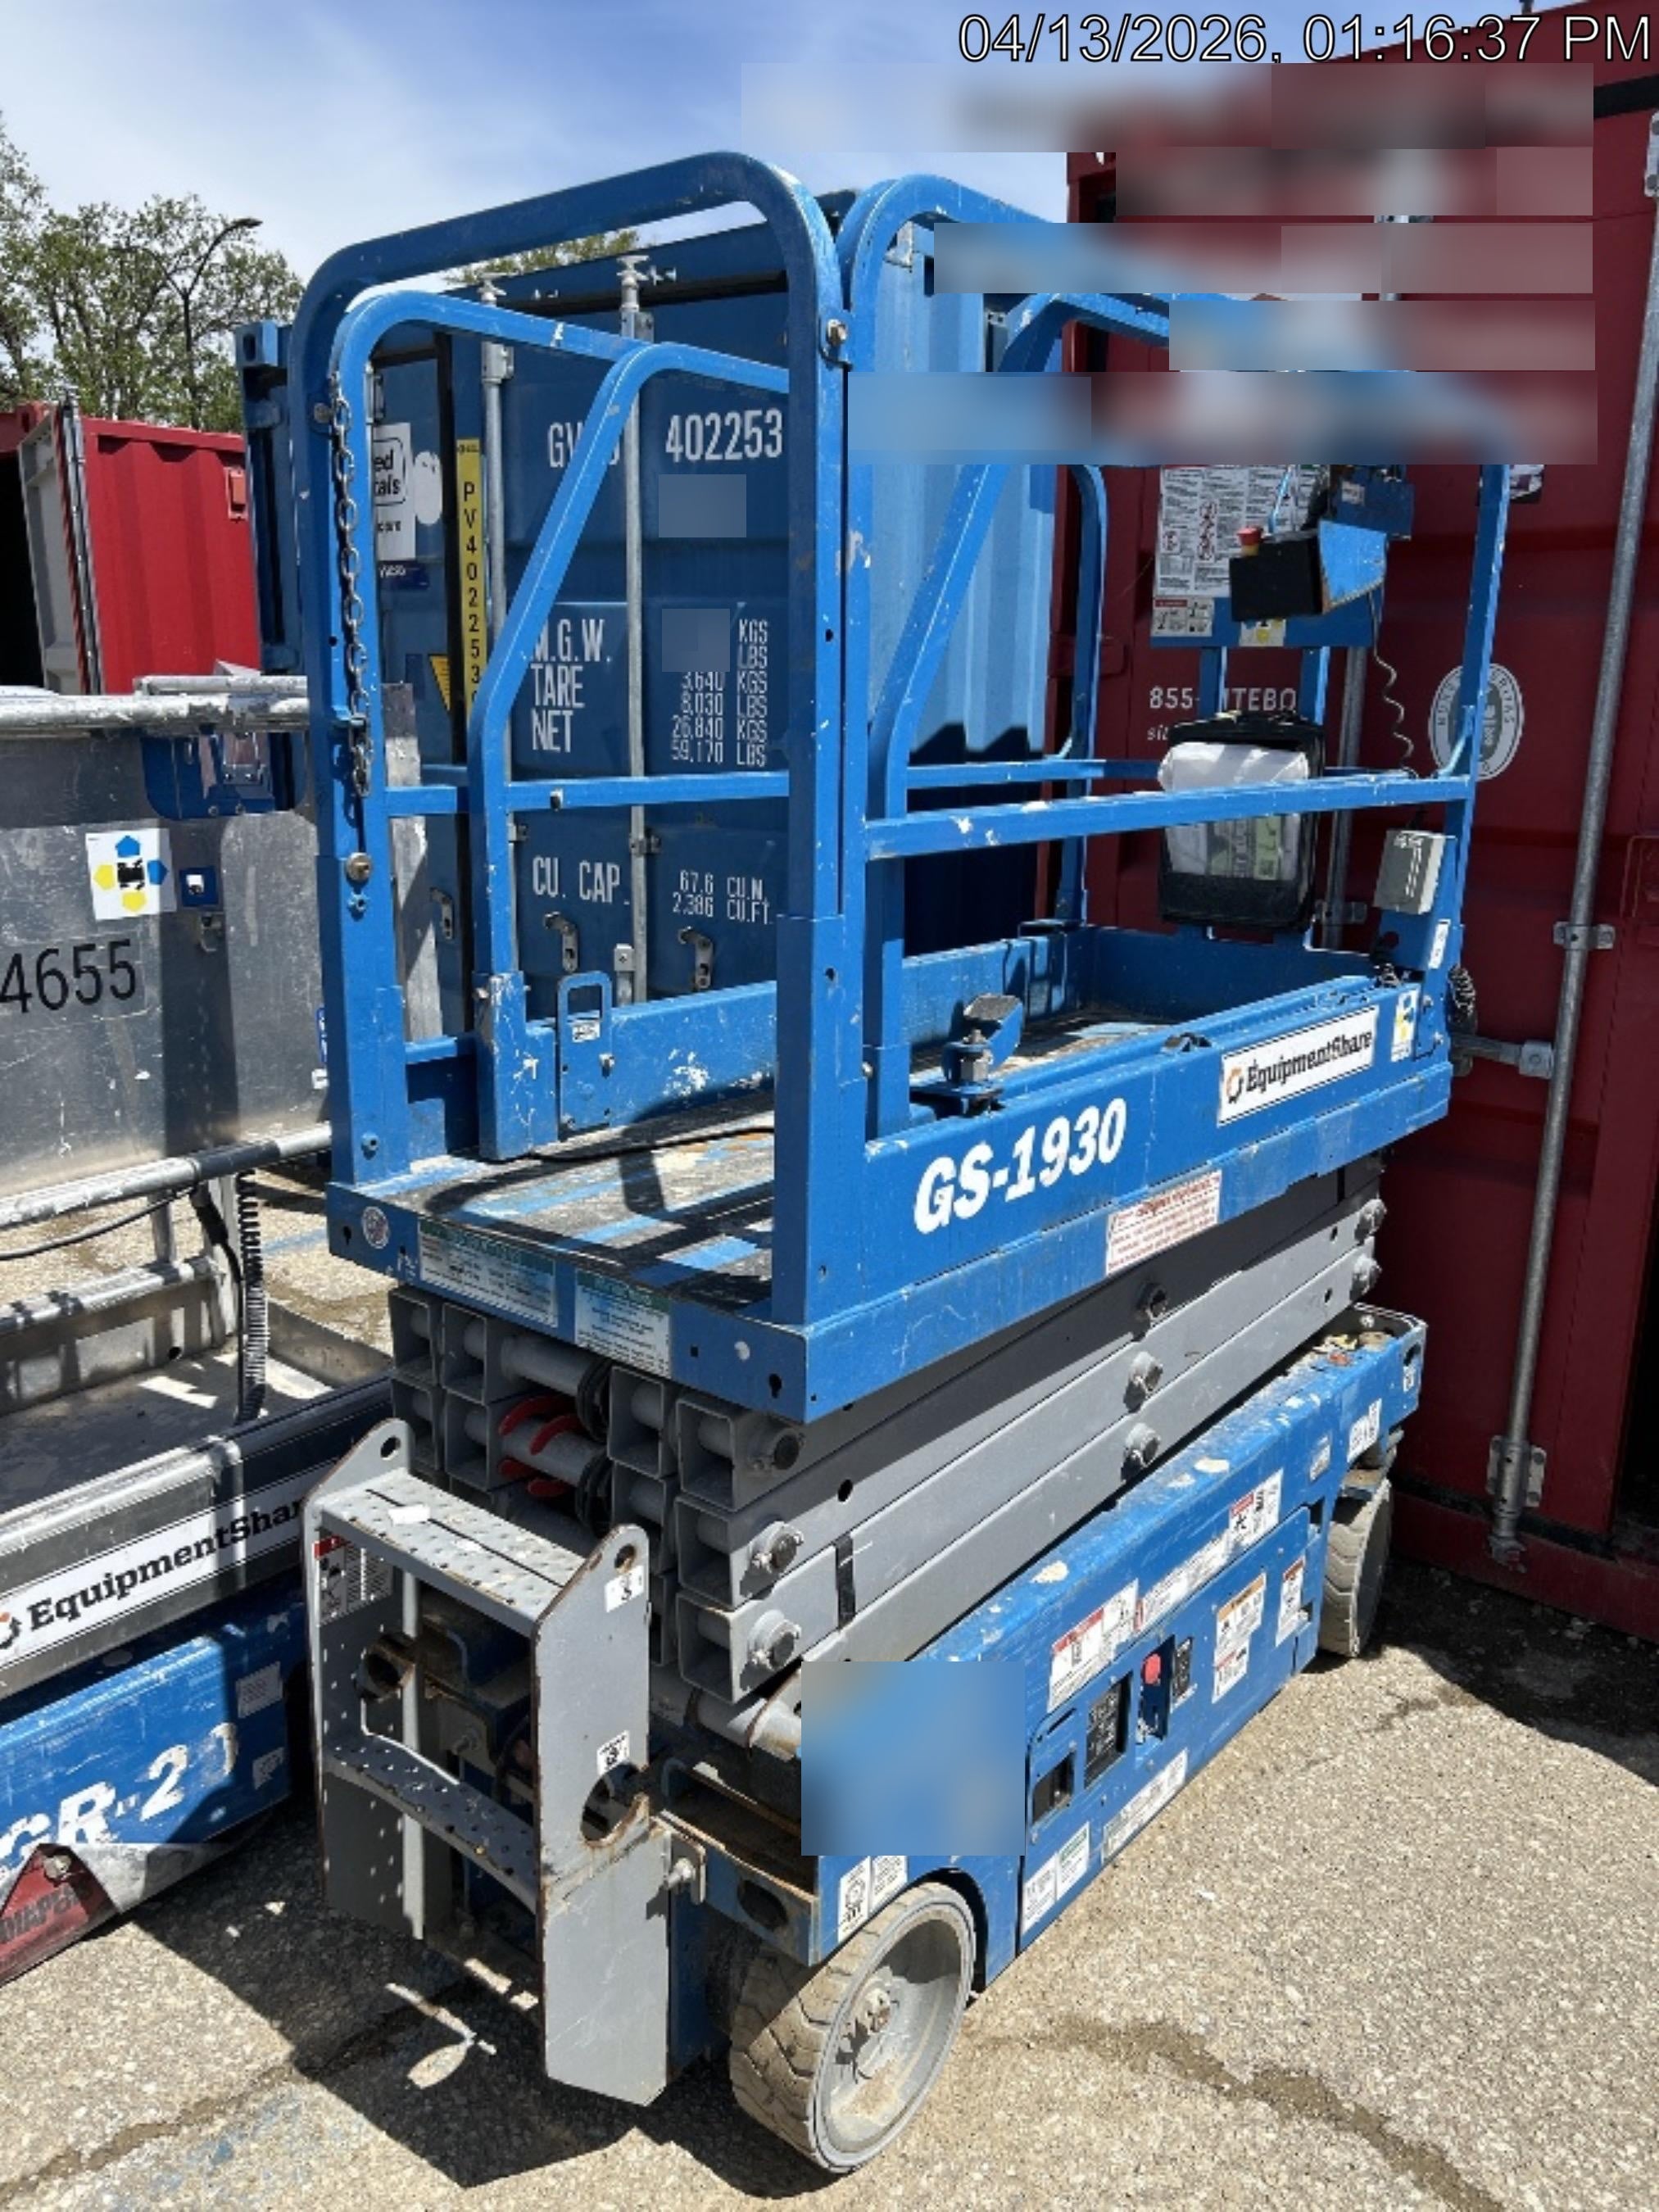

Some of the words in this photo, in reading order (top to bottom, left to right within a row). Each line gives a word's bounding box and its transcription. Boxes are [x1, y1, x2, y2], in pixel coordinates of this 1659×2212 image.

[665, 408, 782, 463] 402253
[739, 619, 768, 644] KGS
[737, 645, 768, 669] LBS
[530, 663, 585, 708] TARE
[737, 670, 768, 694] KGS
[737, 695, 768, 718] LBS
[532, 709, 573, 753] NET
[737, 719, 768, 742] KGS
[737, 741, 767, 767] LBS
[533, 857, 566, 899] CU.
[680, 869, 714, 895] 67.6
[0, 939, 135, 1013] 4655
[1246, 1031, 1372, 1094] EquipmentShare
[913, 1098, 1126, 1235] GS-1930
